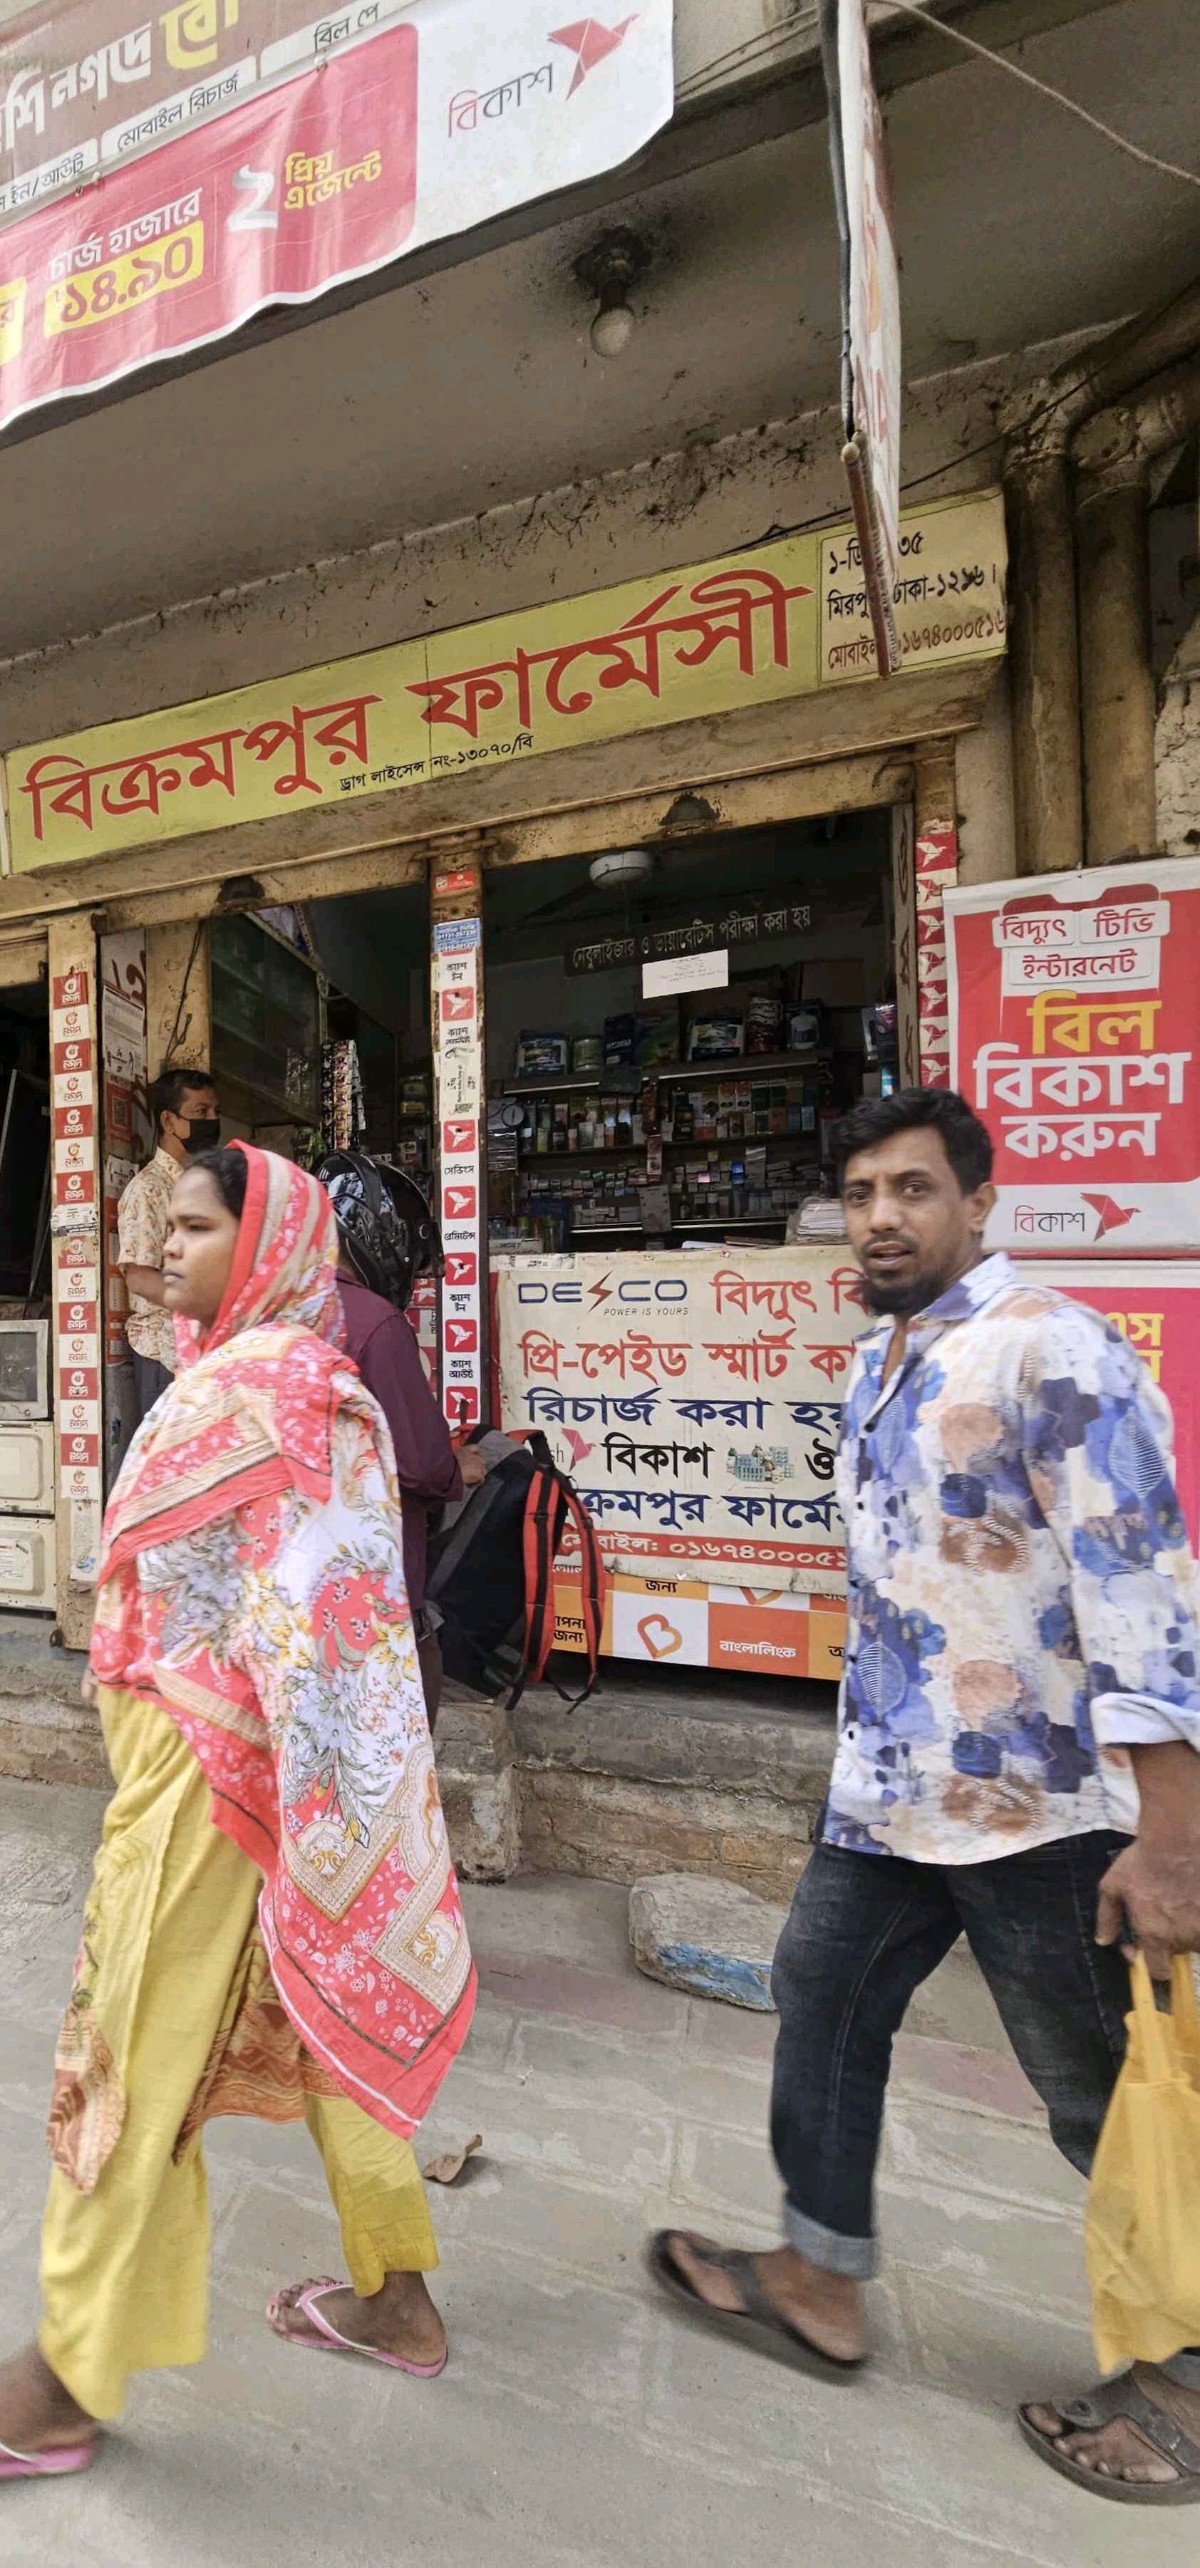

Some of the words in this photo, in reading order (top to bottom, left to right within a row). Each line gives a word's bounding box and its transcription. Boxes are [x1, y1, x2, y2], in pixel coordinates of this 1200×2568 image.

[313, 17, 351, 52] বিল
[0, 62, 45, 150] শি
[117, 104, 182, 152] মোবাইল
[188, 69, 240, 115] রিচার্জ
[449, 62, 553, 139] বিকাশ
[284, 149, 335, 185] প্রিয়
[227, 163, 278, 233] ২
[48, 232, 104, 281] চার্জ
[107, 187, 204, 255] হাজারে
[827, 588, 870, 621] মিরপু
[900, 608, 1007, 654] ১৬৭৪০০০৫১৬
[18, 694, 383, 841] বিক্রমপুর
[404, 569, 815, 738] ফার্মেসী
[370, 759, 426, 783] লাইসেন্স
[763, 908, 788, 932] করা
[792, 905, 811, 929] হয়
[999, 916, 1068, 945] বিদ্যুৎ
[1093, 908, 1156, 939] টিভি
[1022, 948, 1138, 980] ইন্টারনেট
[1026, 989, 1163, 1055] বিল
[972, 1042, 1192, 1110] বিকাশ
[1000, 1112, 1162, 1162] করুন
[1014, 1205, 1086, 1233] বিকাশ
[604, 1307, 638, 1316] POWER
[642, 1307, 651, 1316] IS
[657, 1307, 689, 1316] YOURS
[709, 1268, 818, 1324] বিদ্যুৎ
[826, 1266, 868, 1317] বি
[517, 1329, 694, 1386] প্রি-পেইড
[701, 1328, 798, 1384] স্মার্ট
[802, 1339, 857, 1384] কা
[521, 1386, 663, 1426] রিচার্জ
[670, 1396, 774, 1431] করা
[600, 1431, 716, 1480] বিকাশ
[575, 1489, 713, 1531] ক্রমপুর
[720, 1490, 846, 1533] ফার্মে
[668, 1541, 848, 1568] ০১৬৭৪০০০৫১
[644, 1579, 678, 1594] জন্য
[719, 1639, 797, 1661] বাংলালিংক
